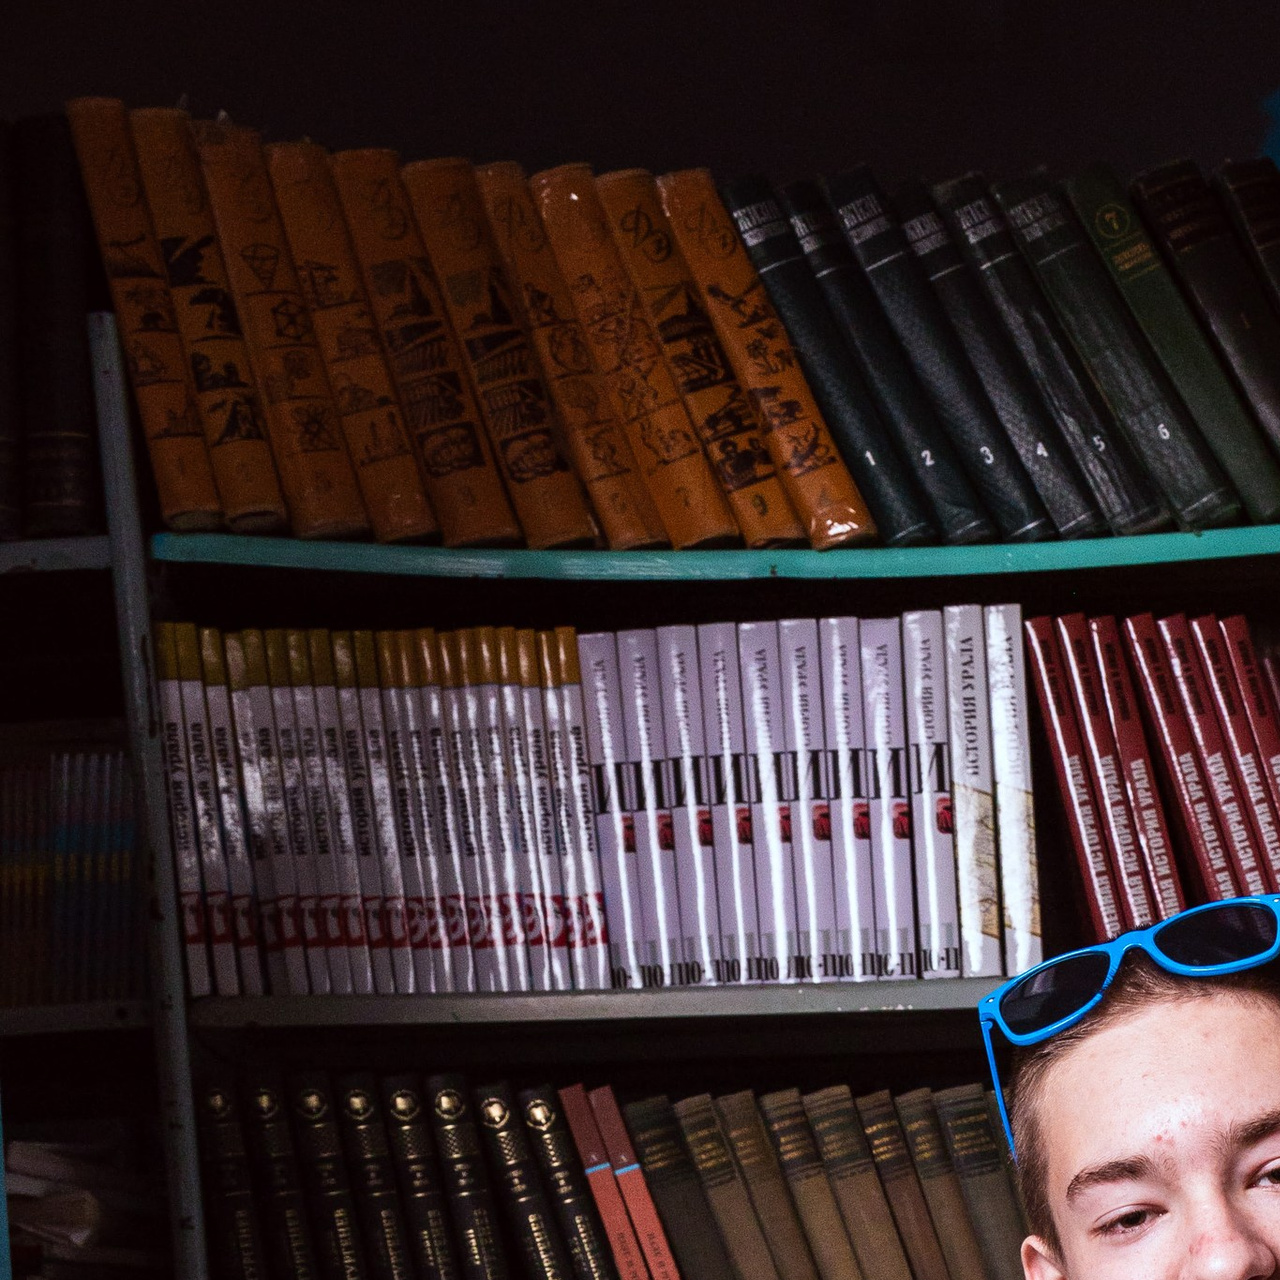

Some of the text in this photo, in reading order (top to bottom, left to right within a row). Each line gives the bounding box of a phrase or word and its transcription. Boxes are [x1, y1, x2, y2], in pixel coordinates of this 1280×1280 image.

[1036, 442, 1049, 457] 4
[1093, 435, 1106, 451] 5
[1157, 423, 1171, 440] 6
[864, 450, 876, 466] 1
[921, 450, 935, 467] 2
[980, 446, 995, 464] 3
[920, 638, 933, 682] УРАЛА
[959, 636, 979, 776] ИСТОРИЯ УРАЛА
[1068, 755, 1092, 802] УРАЛА
[1239, 753, 1266, 799] УРАЛА
[352, 787, 371, 857] история
[1099, 755, 1137, 871] ИСТОРИЯ УРАЛА
[1131, 758, 1171, 874] ИСТОРИЯ УРАЛА
[1179, 752, 1226, 868] ИСТОРИЯ УРАЛА
[1207, 752, 1256, 868] ИСТОРИЯ УРАЛА
[1076, 805, 1106, 871] ИСТОРИЯ
